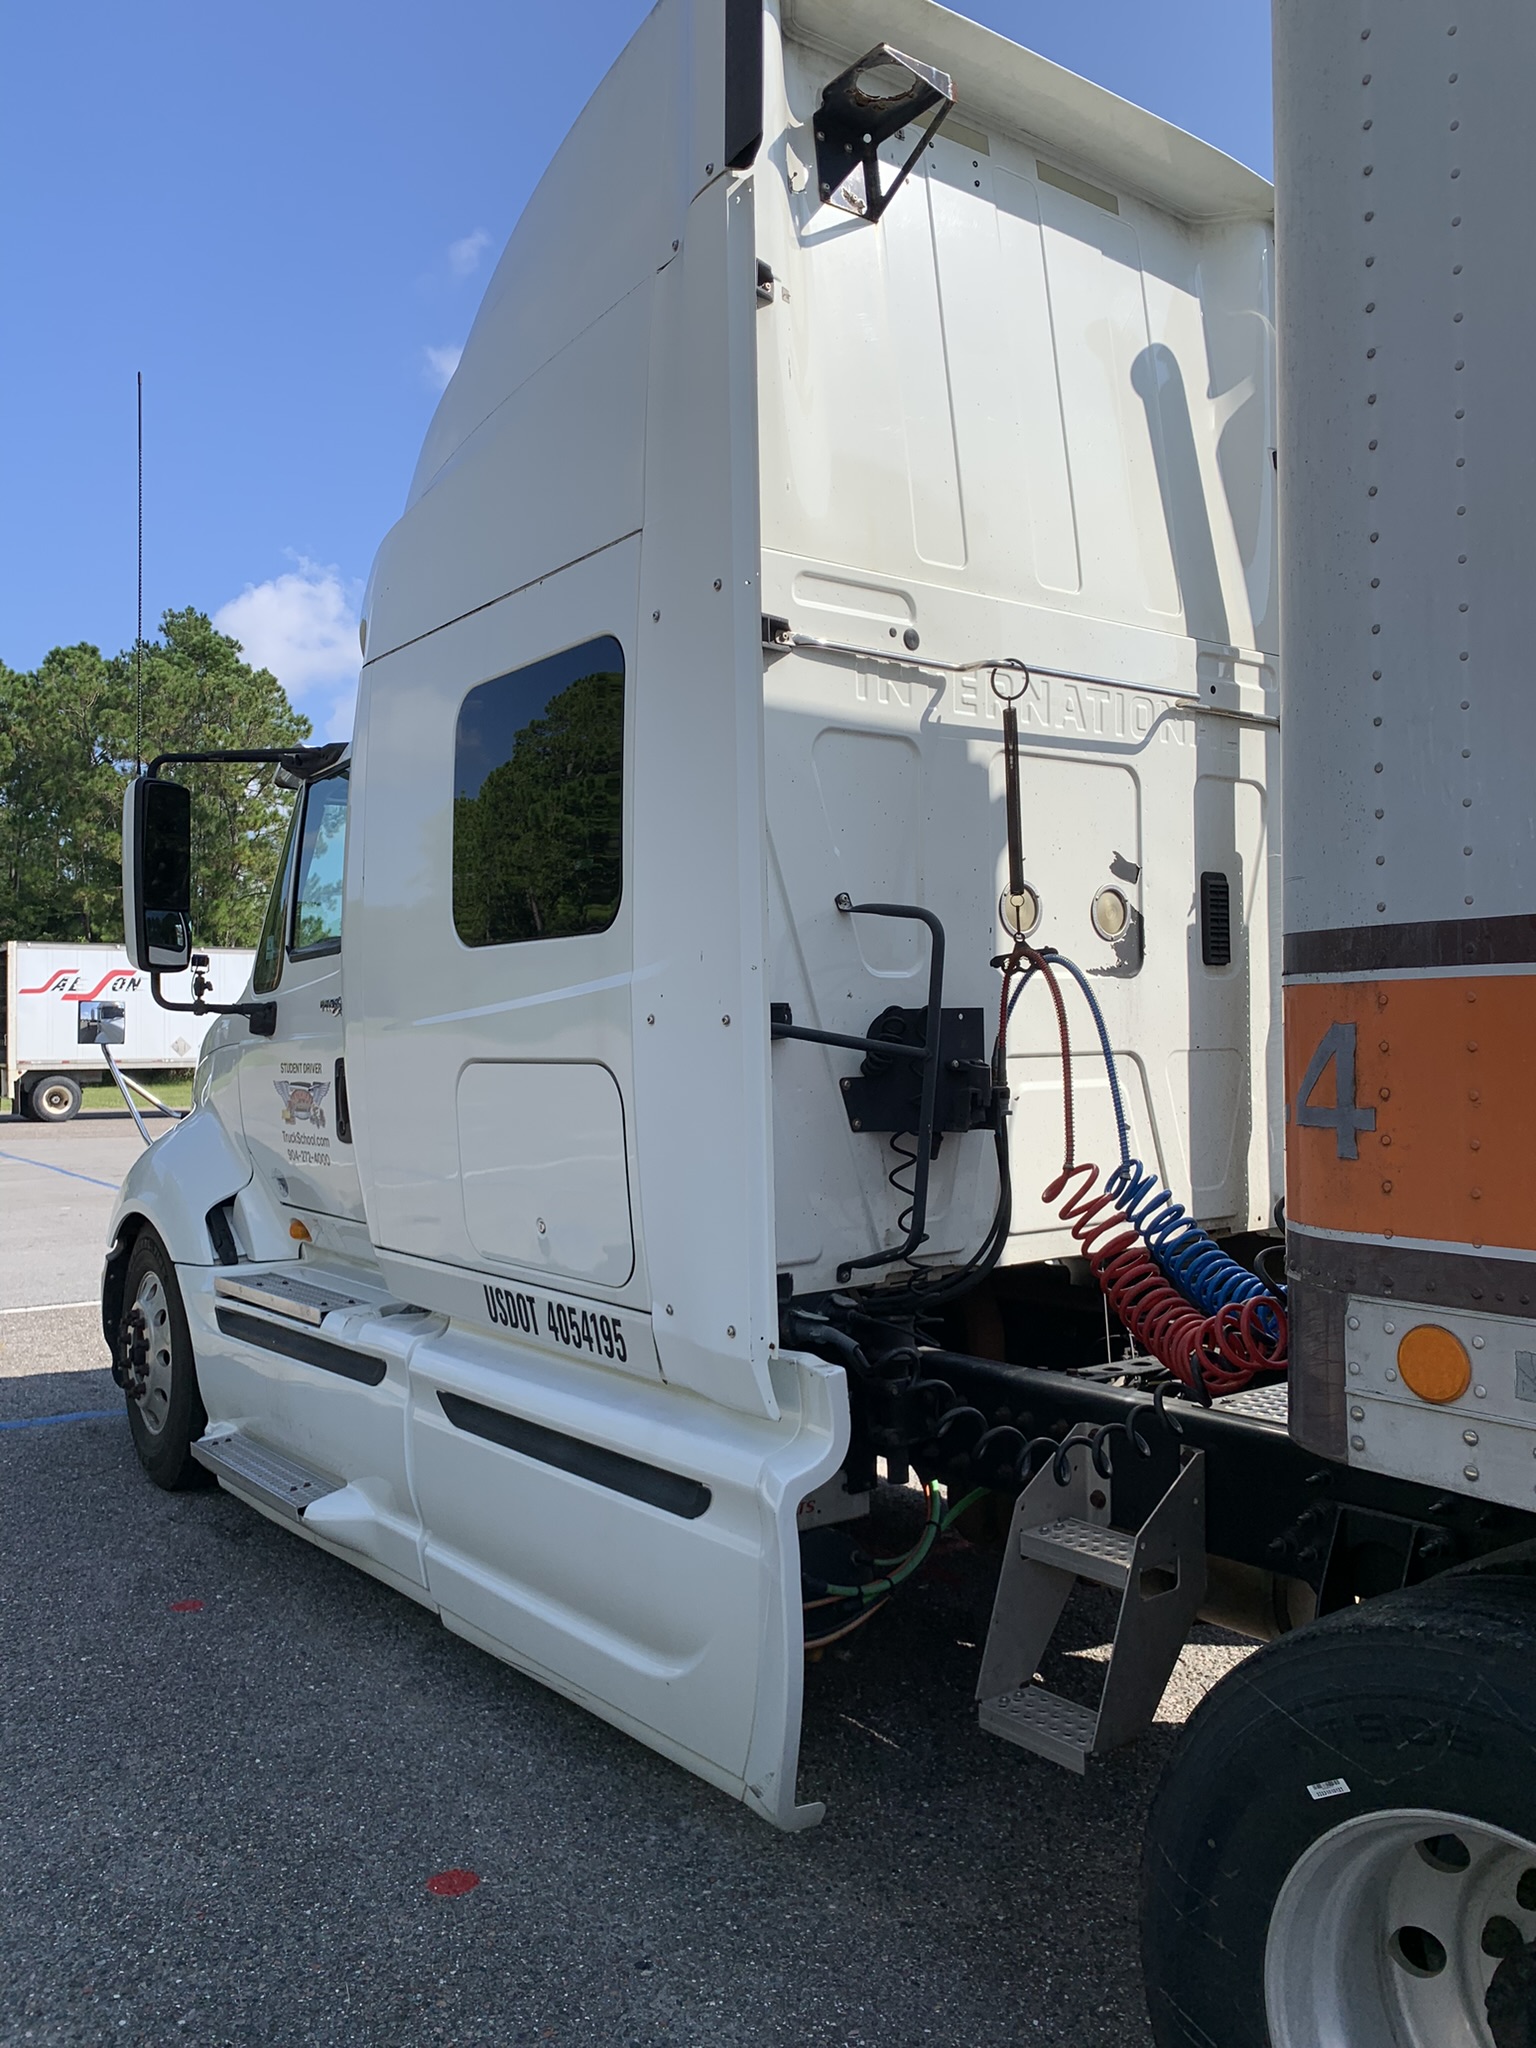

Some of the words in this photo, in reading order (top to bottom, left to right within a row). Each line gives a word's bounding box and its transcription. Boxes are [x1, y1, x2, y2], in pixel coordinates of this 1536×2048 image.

[280, 1062, 303, 1074] STUDENT
[303, 1062, 323, 1074] DRIVER
[1296, 1022, 1376, 1161] 4
[282, 1130, 330, 1148] TruckSchool.com
[287, 1148, 331, 1166] 904-272-4000
[483, 1284, 539, 1336] USDOT
[547, 1301, 627, 1363] 4054195
